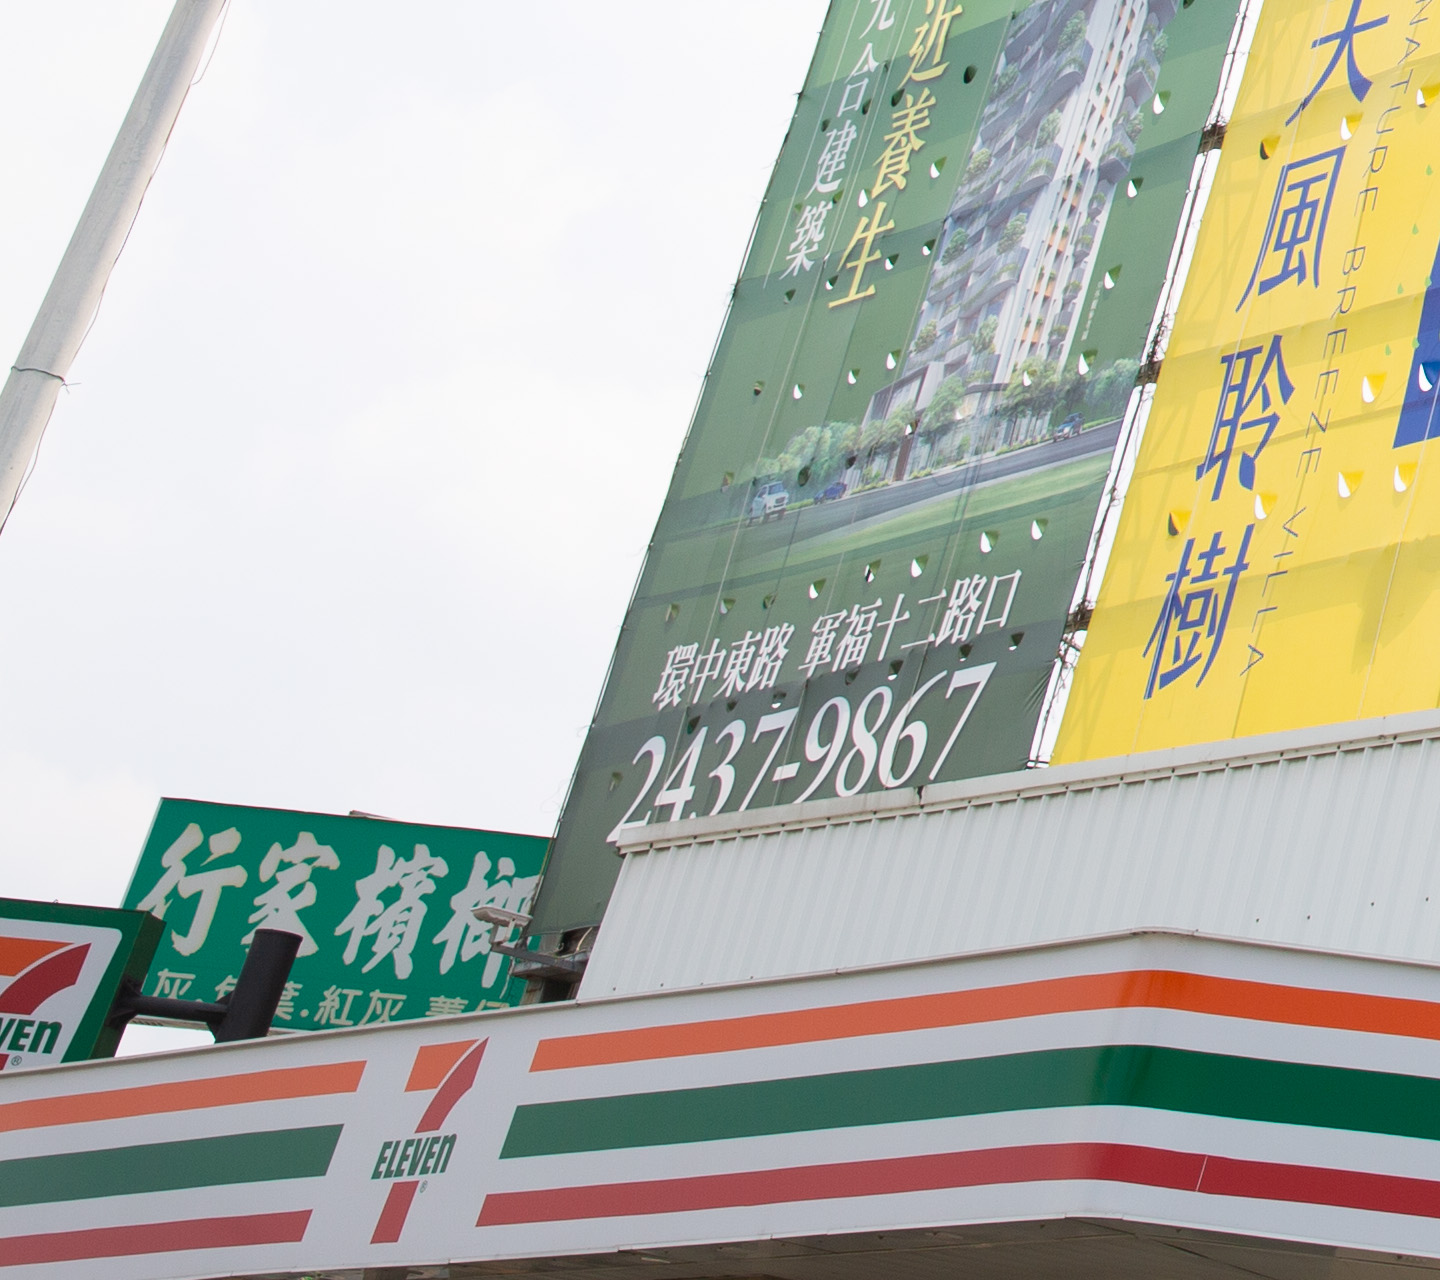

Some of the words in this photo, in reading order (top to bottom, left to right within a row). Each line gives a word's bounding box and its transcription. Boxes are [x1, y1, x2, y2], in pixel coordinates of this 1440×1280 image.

[1295, 244, 1363, 477] BREEZE
[651, 622, 796, 712] 環中東路
[798, 567, 1022, 679] 軍福十二路口
[1239, 505, 1310, 678] VILLA
[606, 661, 998, 842] 2437-9867
